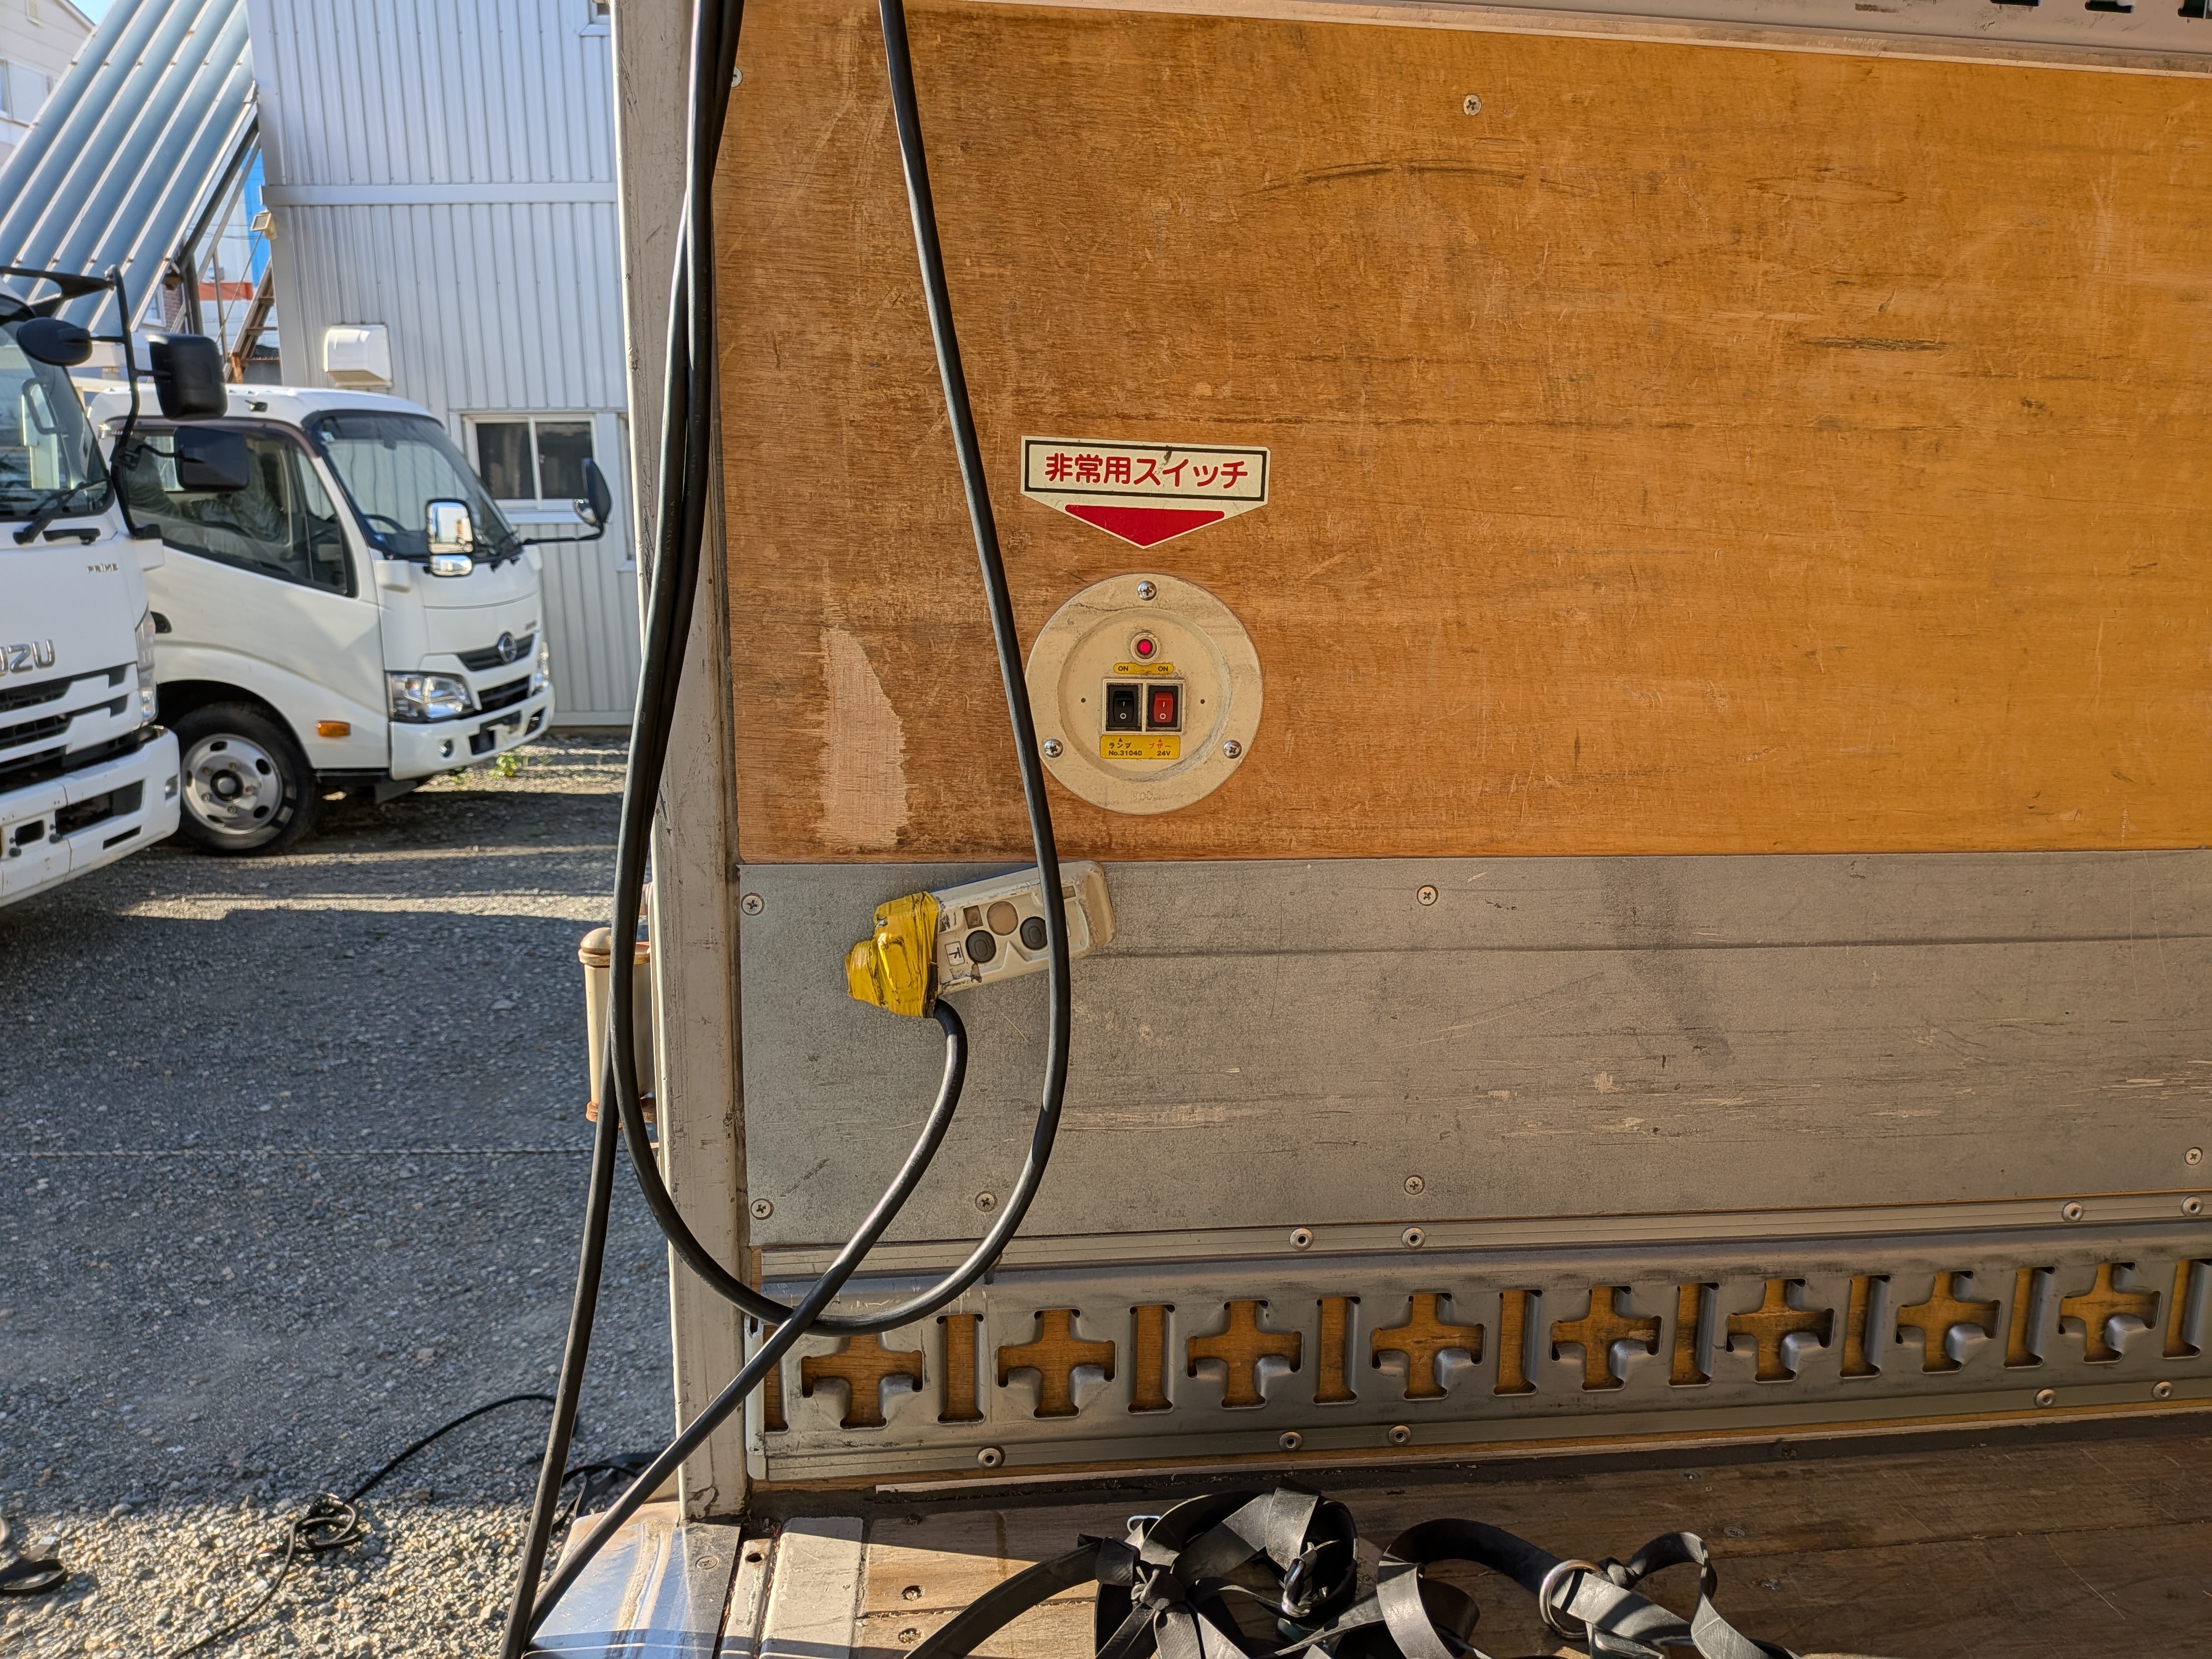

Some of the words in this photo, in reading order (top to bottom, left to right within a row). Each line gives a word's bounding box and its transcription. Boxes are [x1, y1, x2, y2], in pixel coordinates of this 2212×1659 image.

[1045, 452, 1248, 489] 非常用スイッチ
[948, 947, 962, 959] 下
